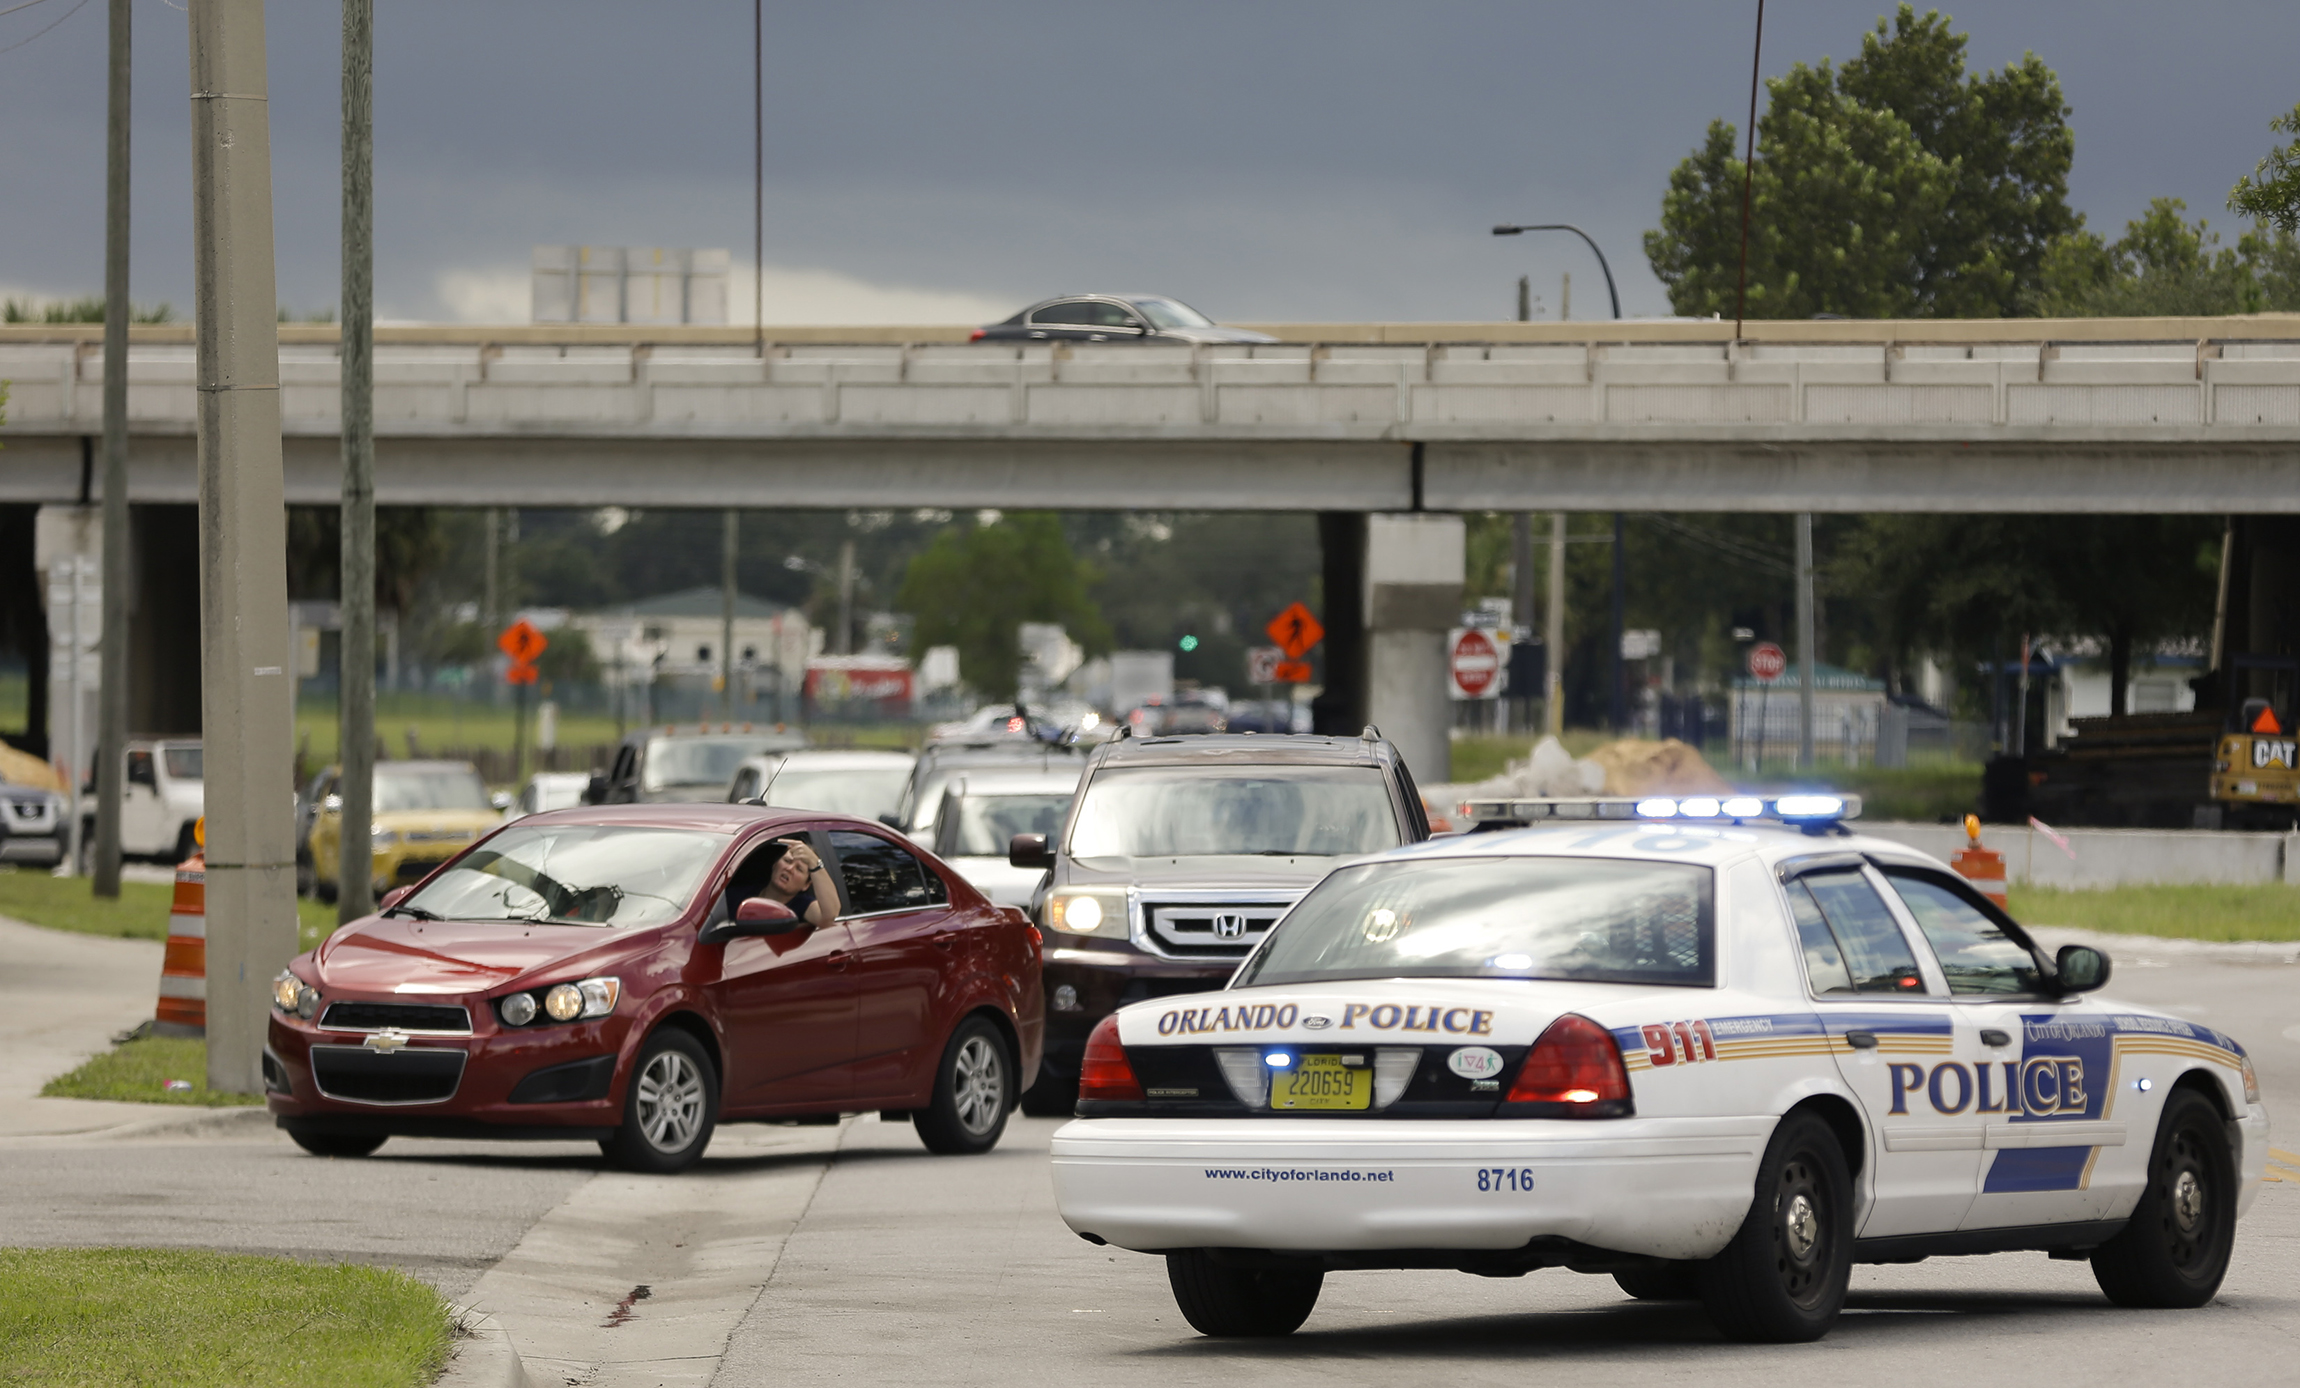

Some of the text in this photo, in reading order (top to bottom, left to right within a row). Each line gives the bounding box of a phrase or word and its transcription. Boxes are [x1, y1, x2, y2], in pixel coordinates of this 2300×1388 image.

[1754, 656, 1784, 669] STOP
[2254, 740, 2296, 769] CAT
[1158, 1003, 1494, 1037] ORLANDO POLICE
[1712, 1018, 1774, 1036] EMERGENCY
[1640, 1019, 1718, 1067] 911
[1289, 1070, 1354, 1096] 220659
[1886, 1056, 2088, 1116] POLICE
[1205, 1168, 1394, 1182] www.cityoforlando.net
[1478, 1168, 1534, 1191] 8716
